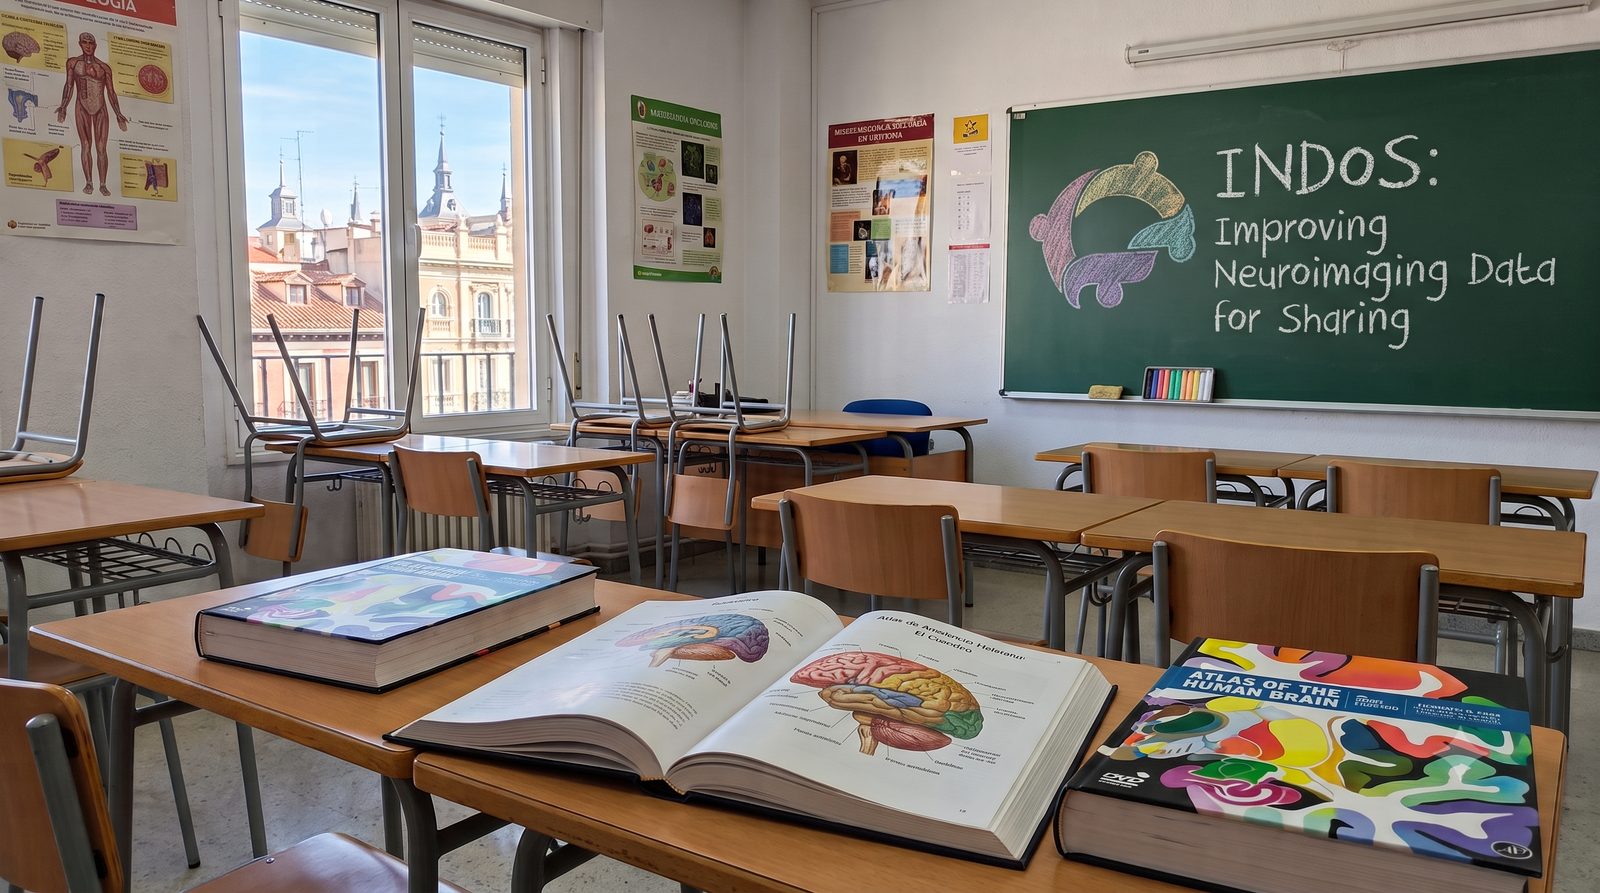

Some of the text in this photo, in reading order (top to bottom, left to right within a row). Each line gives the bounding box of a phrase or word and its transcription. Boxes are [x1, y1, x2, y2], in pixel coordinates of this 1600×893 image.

[1215, 209, 1388, 258] Improving
[1214, 252, 1556, 302] Neuroimaging Data
[1215, 300, 1410, 350] for Sharing
[877, 615, 903, 623] Atlas
[1182, 679, 1263, 697] HUMAN
[1268, 690, 1340, 708] BRAIN
[1189, 670, 1342, 698] ATLAS OF THE
